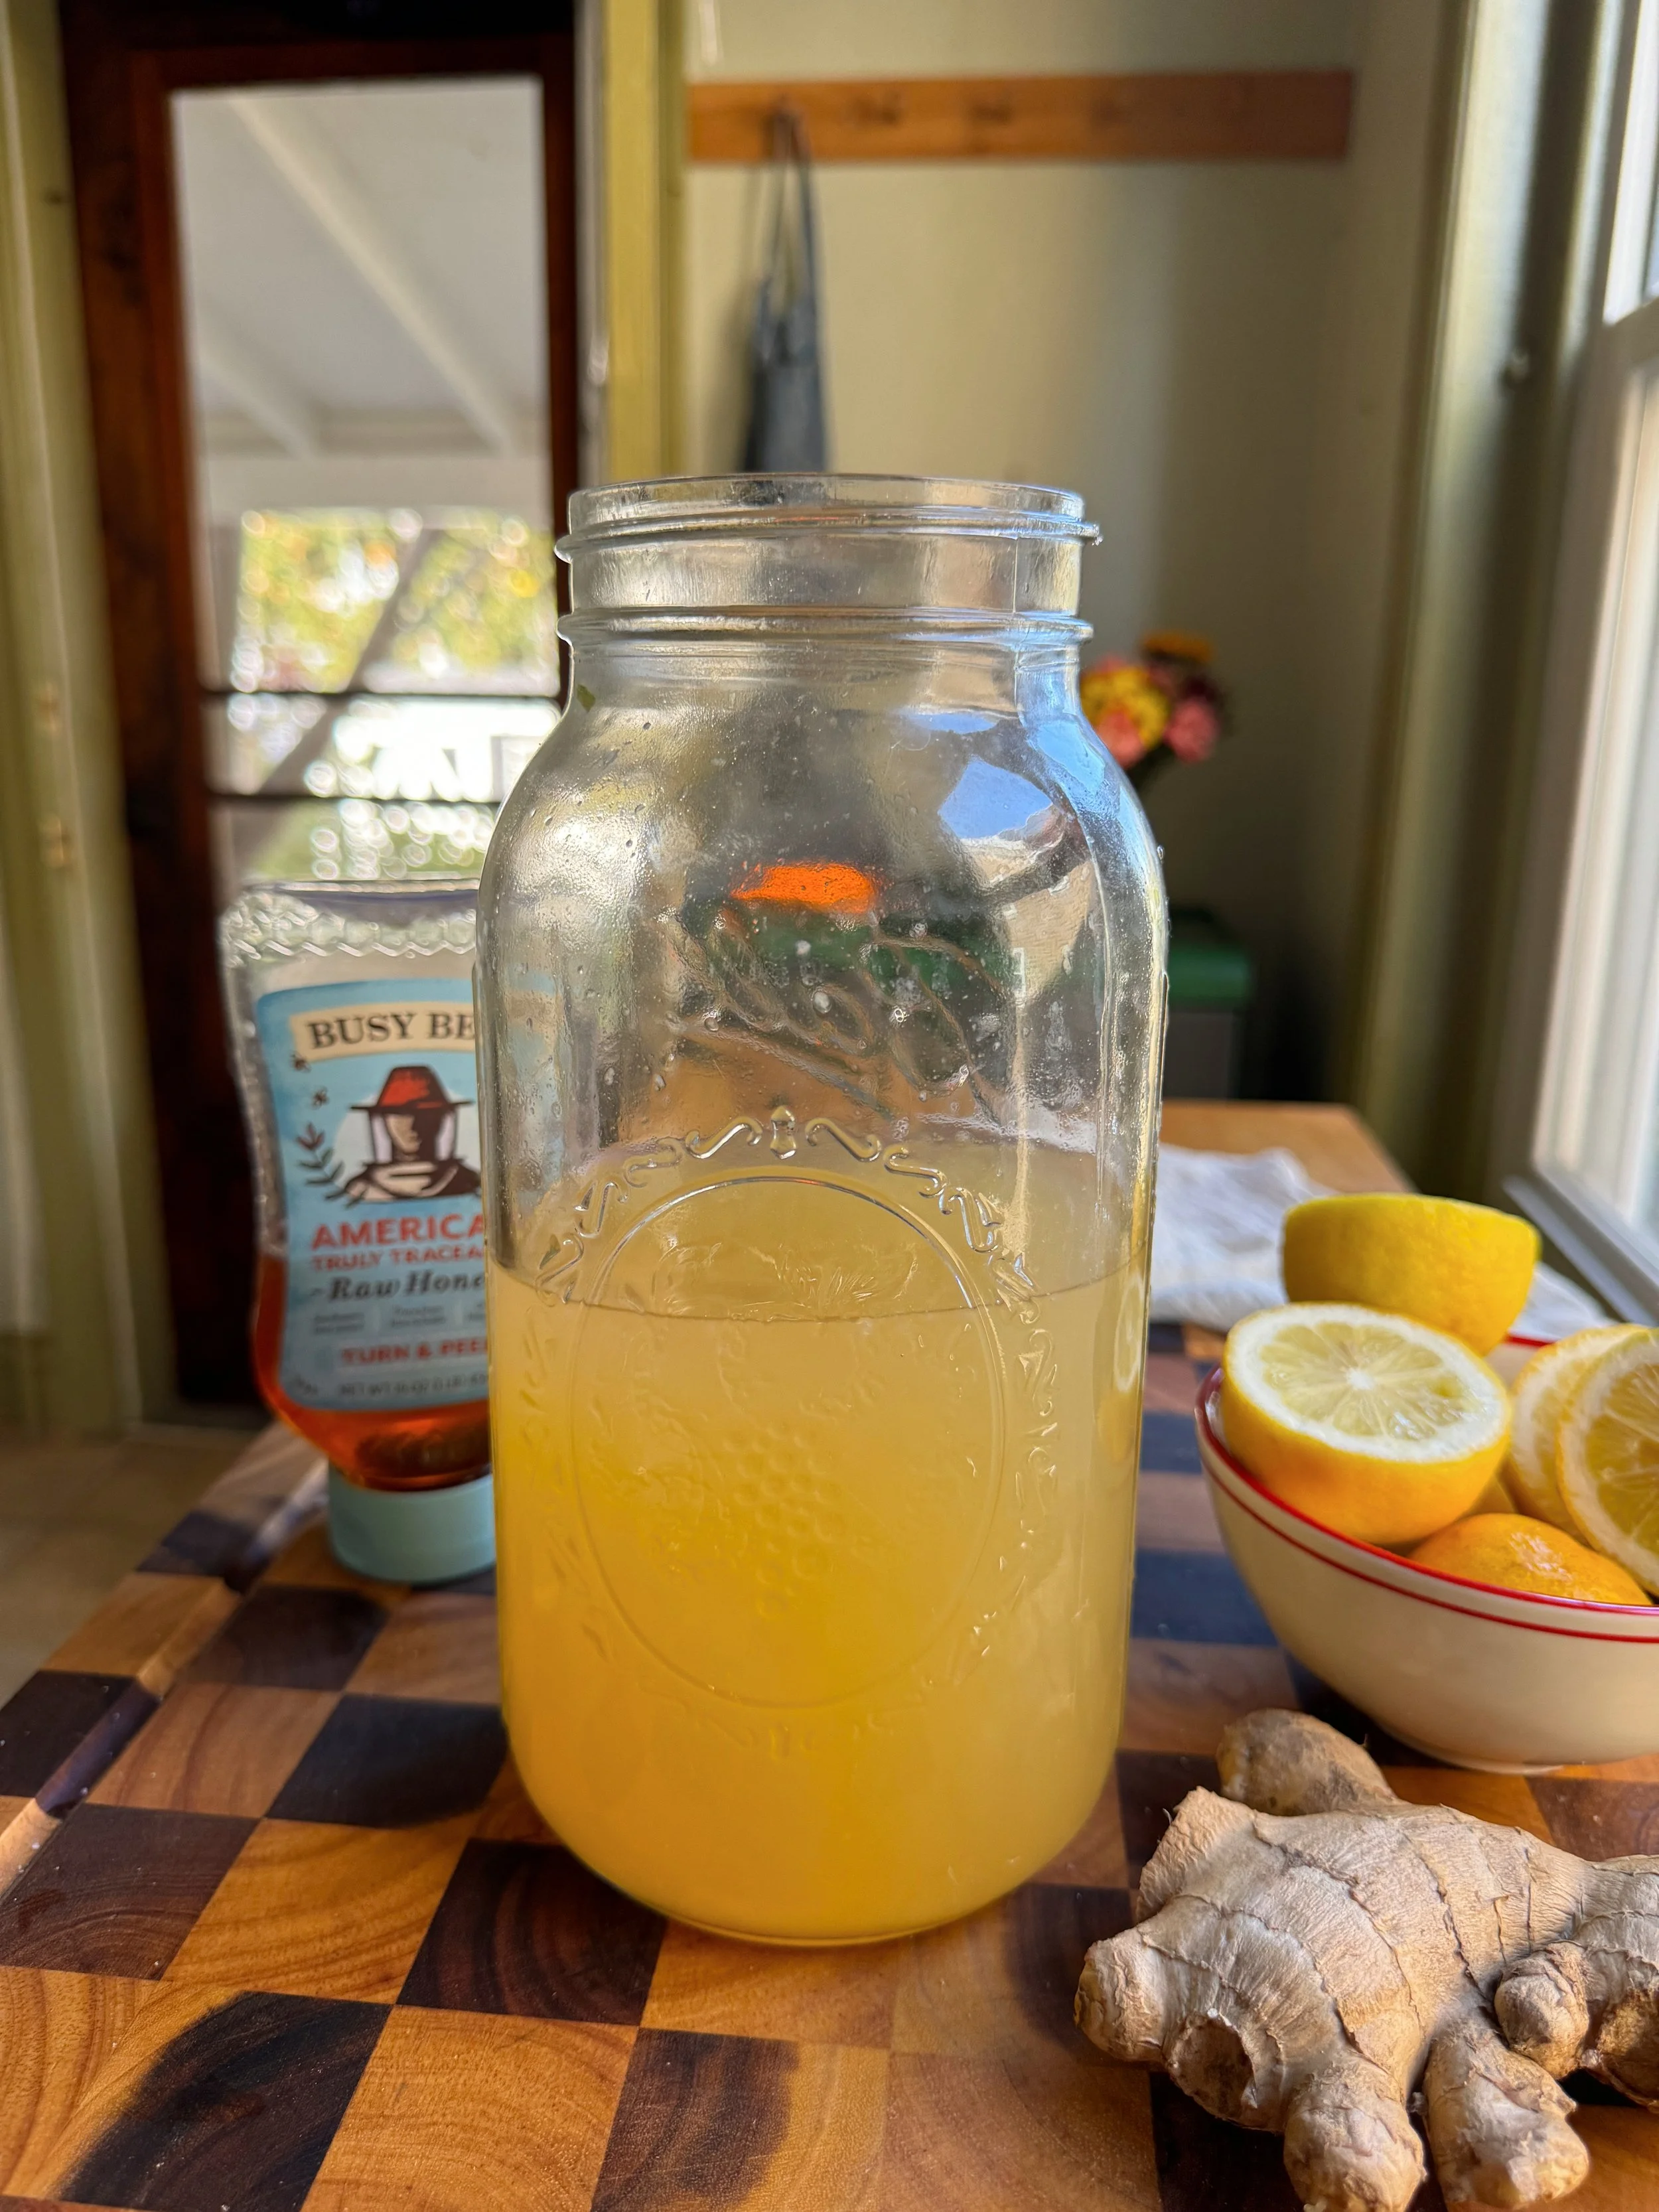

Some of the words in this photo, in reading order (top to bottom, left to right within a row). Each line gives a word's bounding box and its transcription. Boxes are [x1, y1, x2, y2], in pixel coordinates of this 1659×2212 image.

[306, 1011, 417, 1049] BUSY
[313, 1250, 382, 1272] TRULY
[328, 1275, 398, 1301] Raw
[341, 1343, 409, 1364] TURN
